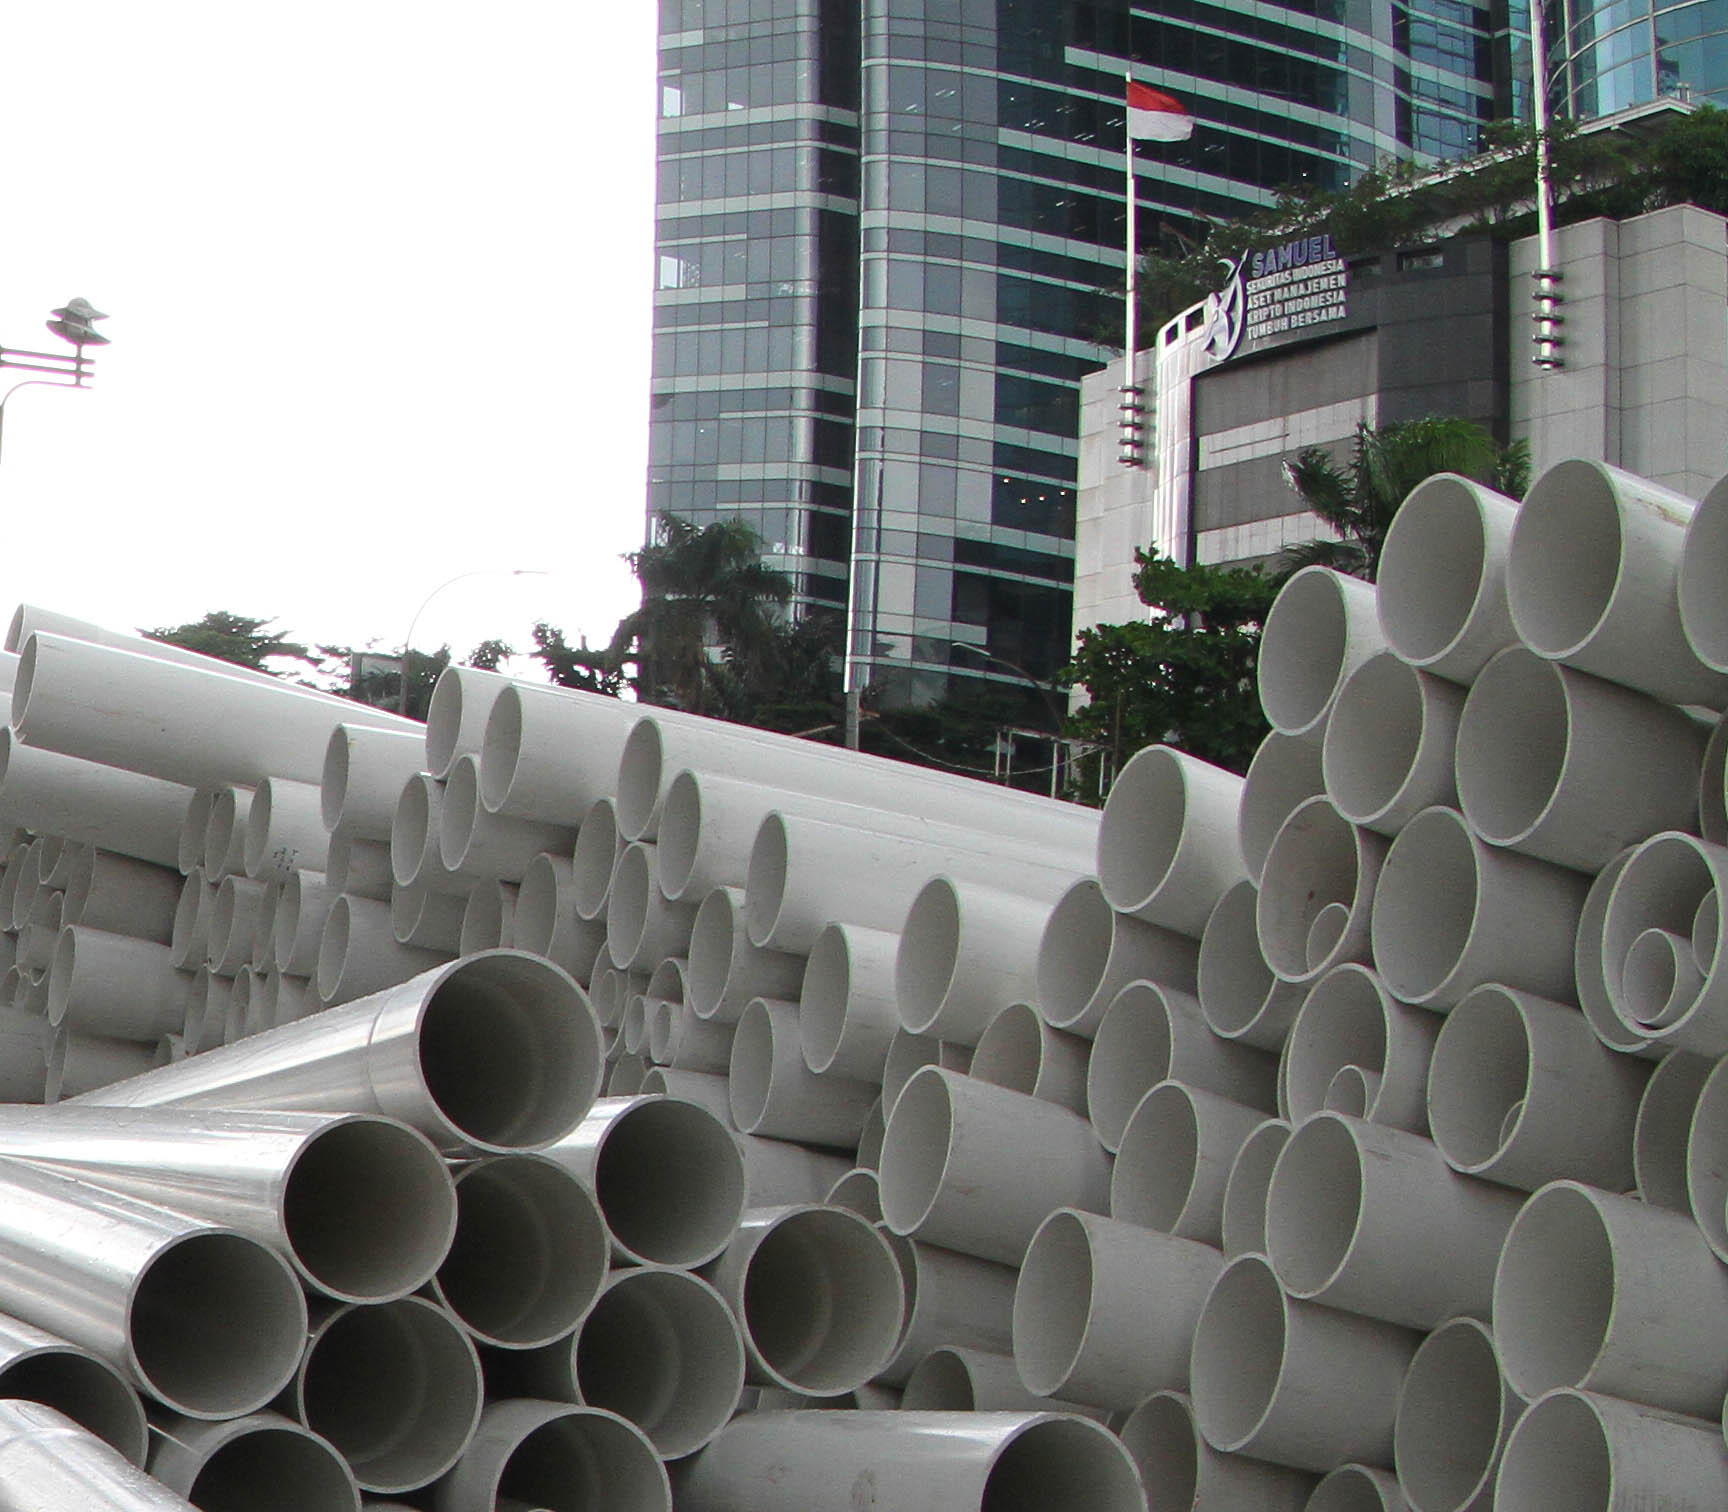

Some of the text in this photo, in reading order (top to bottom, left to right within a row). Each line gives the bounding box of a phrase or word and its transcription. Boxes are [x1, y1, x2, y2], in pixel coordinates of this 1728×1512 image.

[1252, 234, 1336, 277] SAMUEL
[1292, 259, 1345, 282] INDONESIA
[1247, 273, 1347, 310] ASET MANAJEMEN
[1247, 289, 1346, 326] KRIPTO INDONESIA
[1247, 305, 1346, 340] TUMBUH BERSAMA
